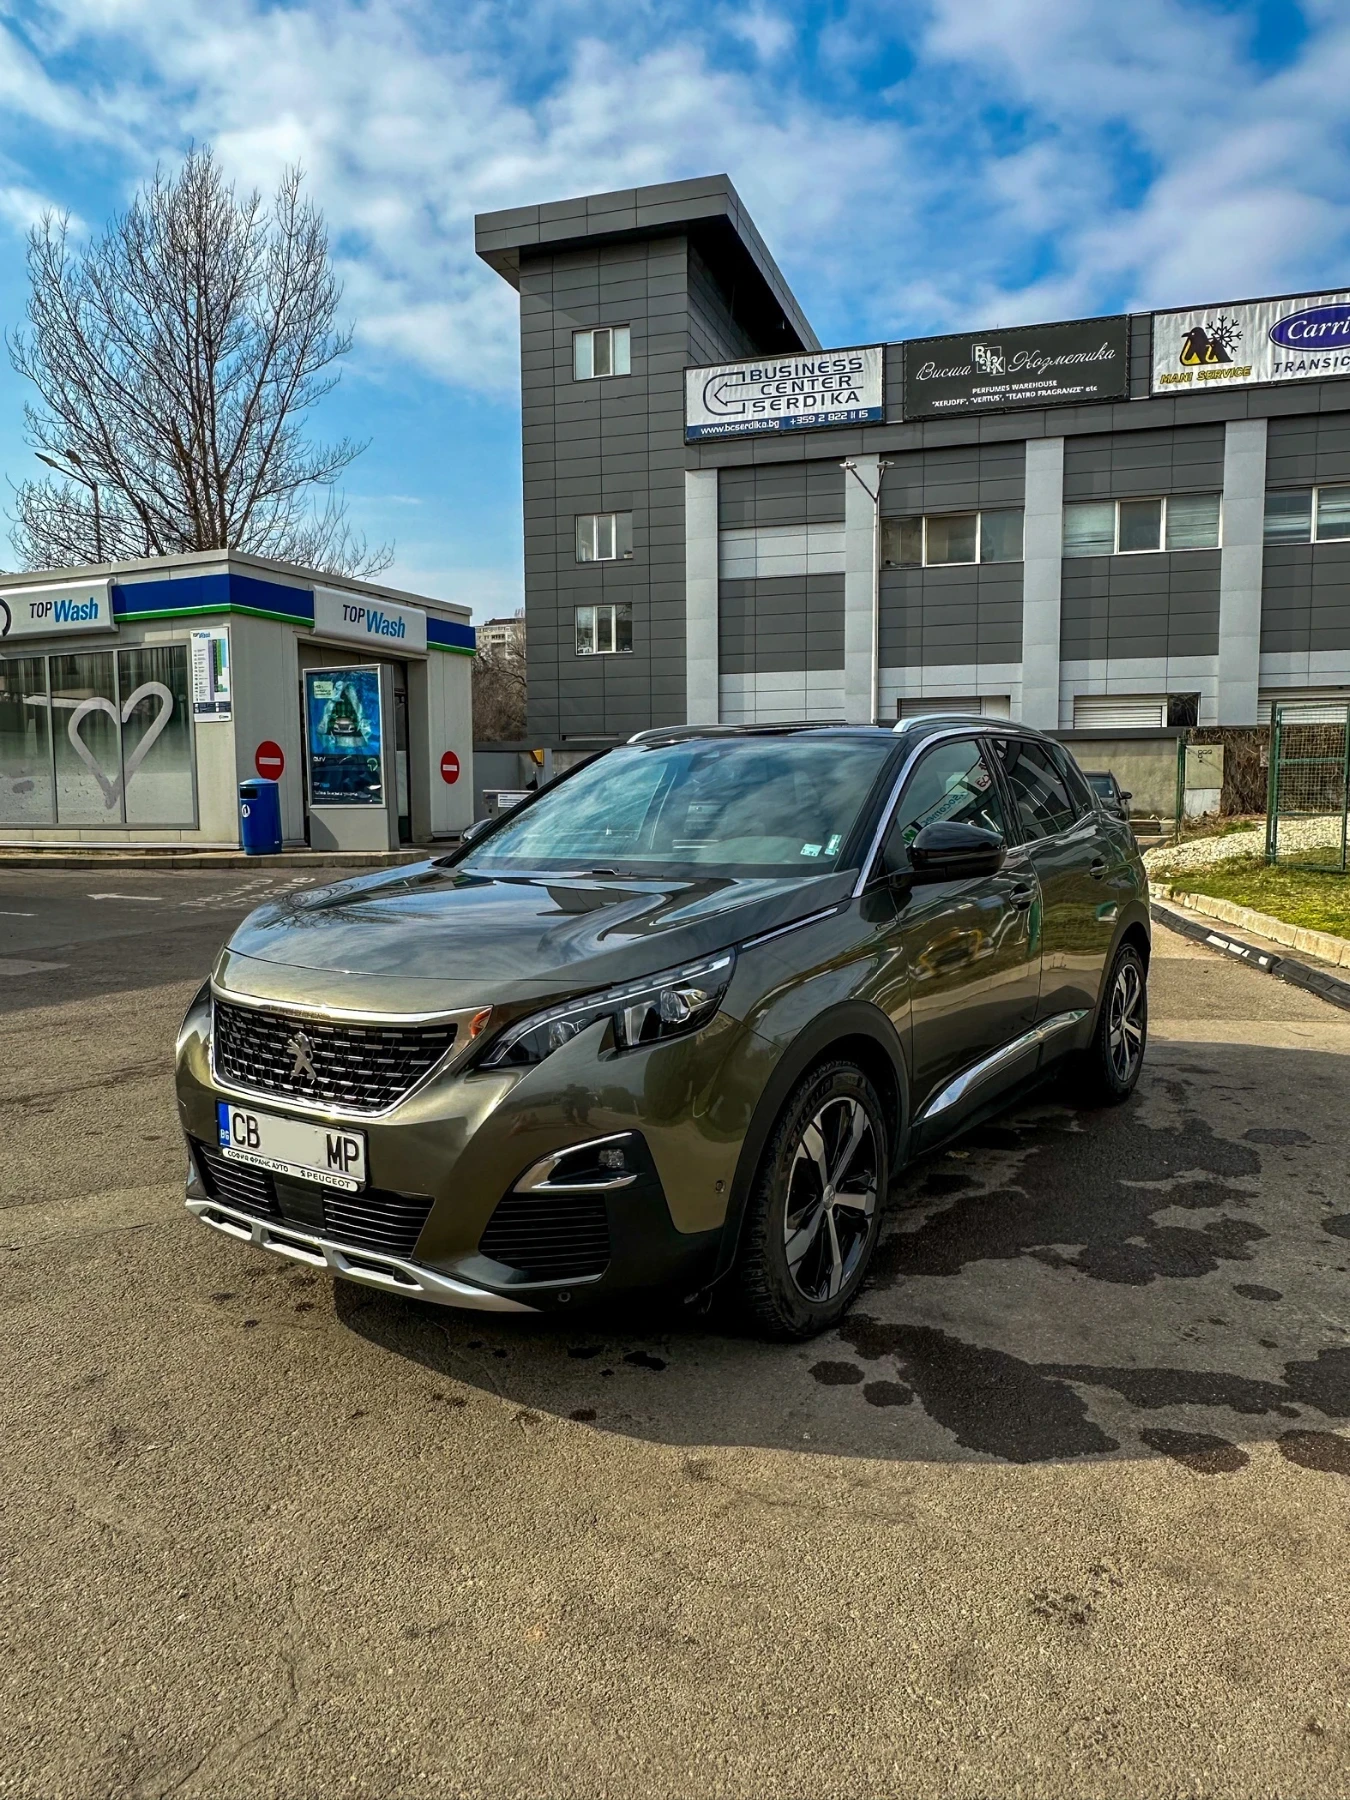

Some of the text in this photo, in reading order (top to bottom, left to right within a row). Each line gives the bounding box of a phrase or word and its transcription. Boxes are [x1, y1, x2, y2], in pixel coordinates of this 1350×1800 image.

[1287, 315, 1350, 340] Carri
[750, 357, 863, 381] BUSINESS
[916, 342, 1116, 380] Висша Козметика
[1273, 356, 1350, 373] TRANSIC
[761, 375, 852, 396] CENTER
[1160, 366, 1252, 384] MANI SERVICE
[972, 380, 1058, 394] PERFUMES WAREHOUSE
[752, 390, 860, 413] SERDIKA
[700, 419, 780, 435] www.bcserdika.bg
[790, 415, 816, 426] +359
[818, 414, 826, 422] 2
[828, 412, 848, 421] 822
[858, 410, 868, 418] 15
[220, 1128, 230, 1141] BG
[232, 1112, 360, 1173] CB MP
[307, 1171, 350, 1189] PEUGEOT
